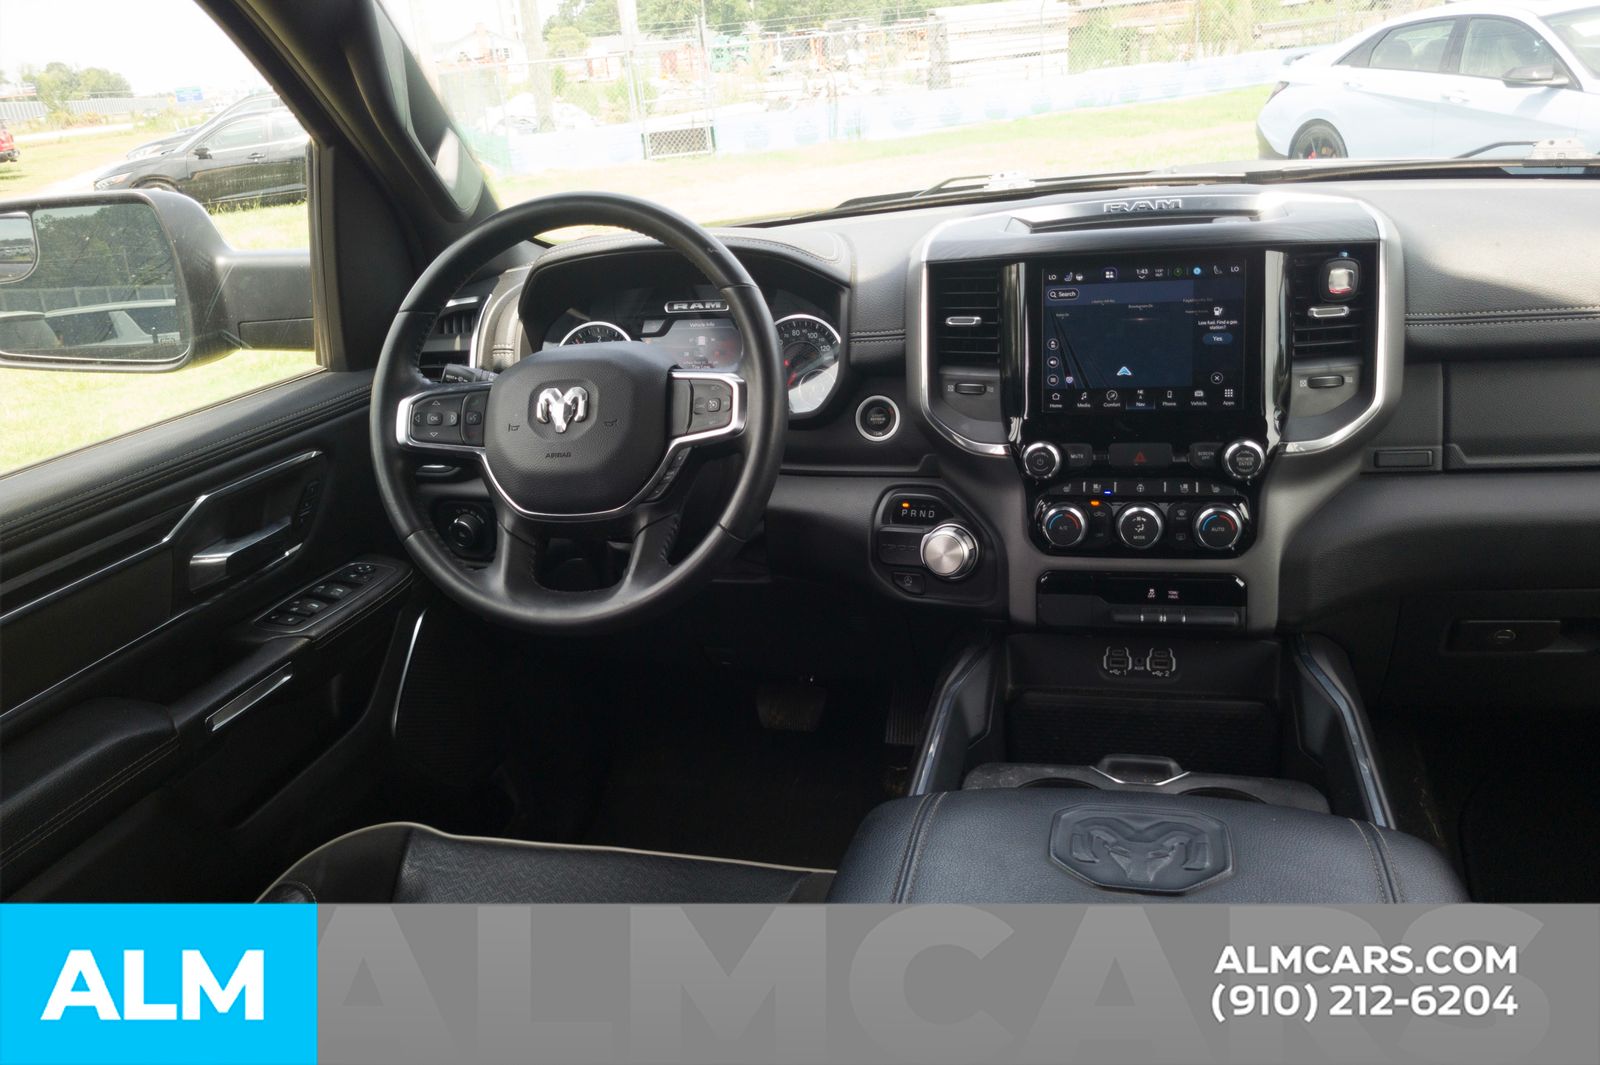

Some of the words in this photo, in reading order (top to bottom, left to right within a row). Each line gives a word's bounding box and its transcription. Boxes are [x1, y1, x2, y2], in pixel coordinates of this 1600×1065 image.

[1103, 199, 1182, 213] RAM
[673, 302, 721, 310] RAM
[807, 332, 818, 340] 100
